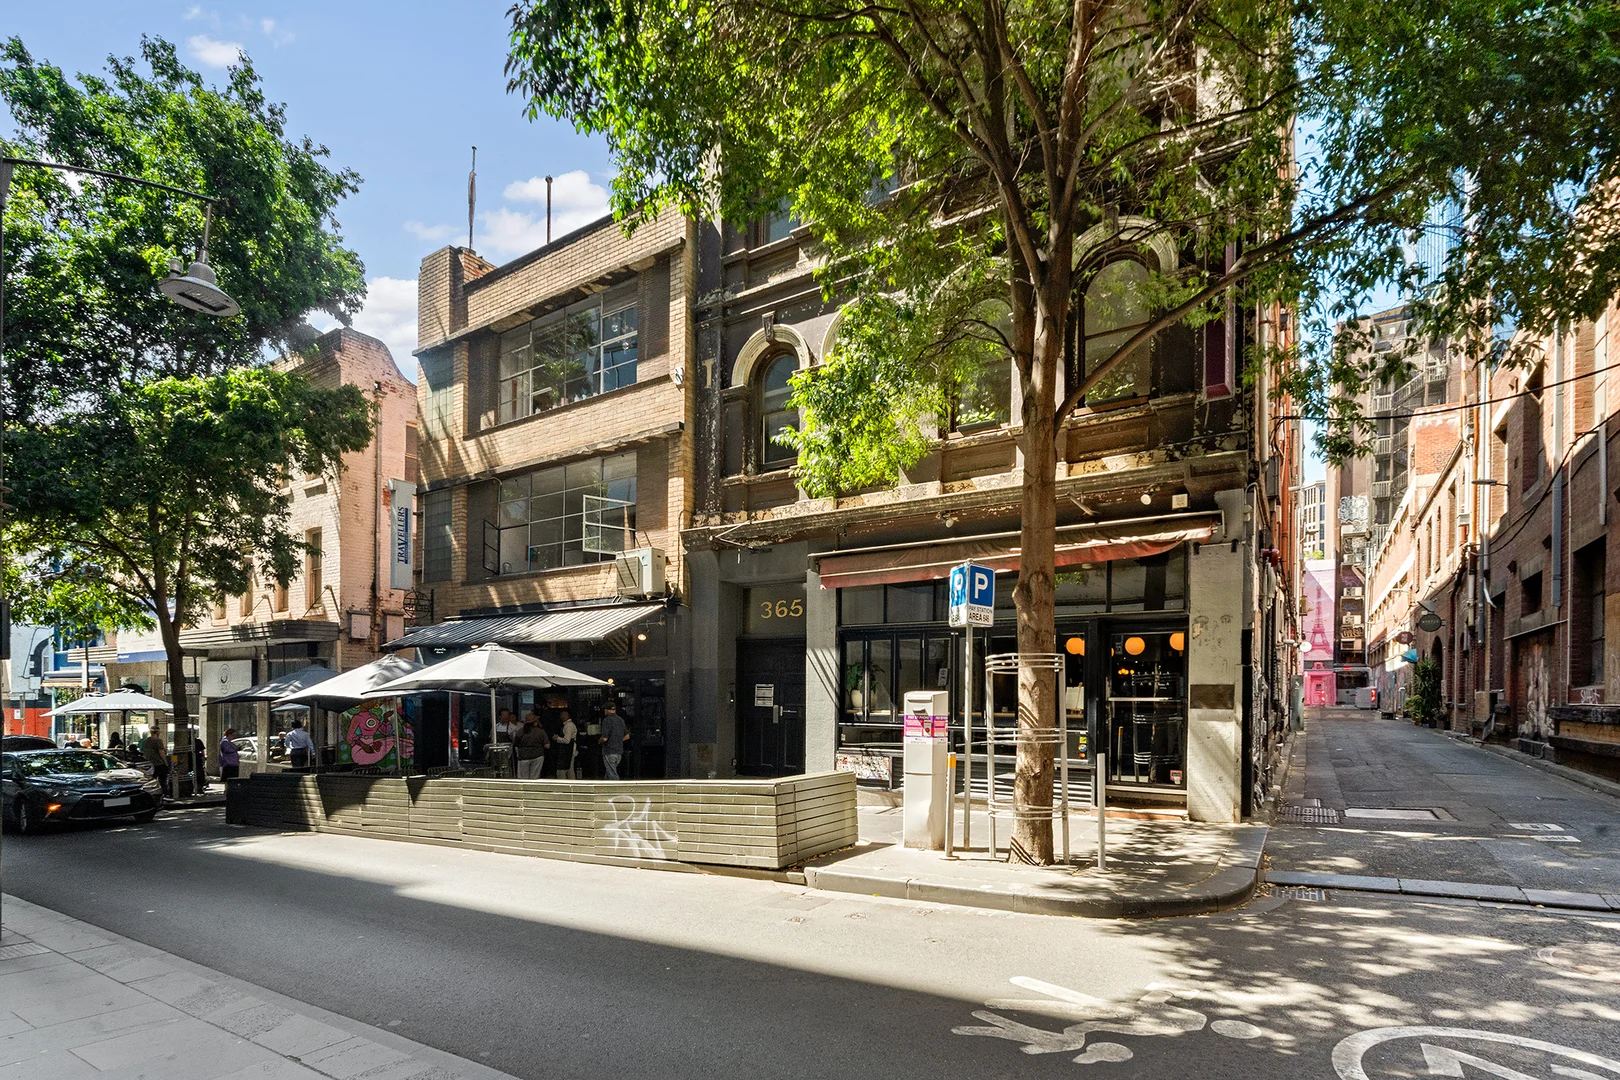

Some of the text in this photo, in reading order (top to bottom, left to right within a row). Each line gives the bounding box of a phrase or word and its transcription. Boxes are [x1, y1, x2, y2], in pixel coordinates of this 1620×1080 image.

[397, 506, 406, 564] TRAVELLERS
[974, 572, 989, 599] P
[760, 598, 804, 619] 365
[968, 612, 982, 622] AREA
